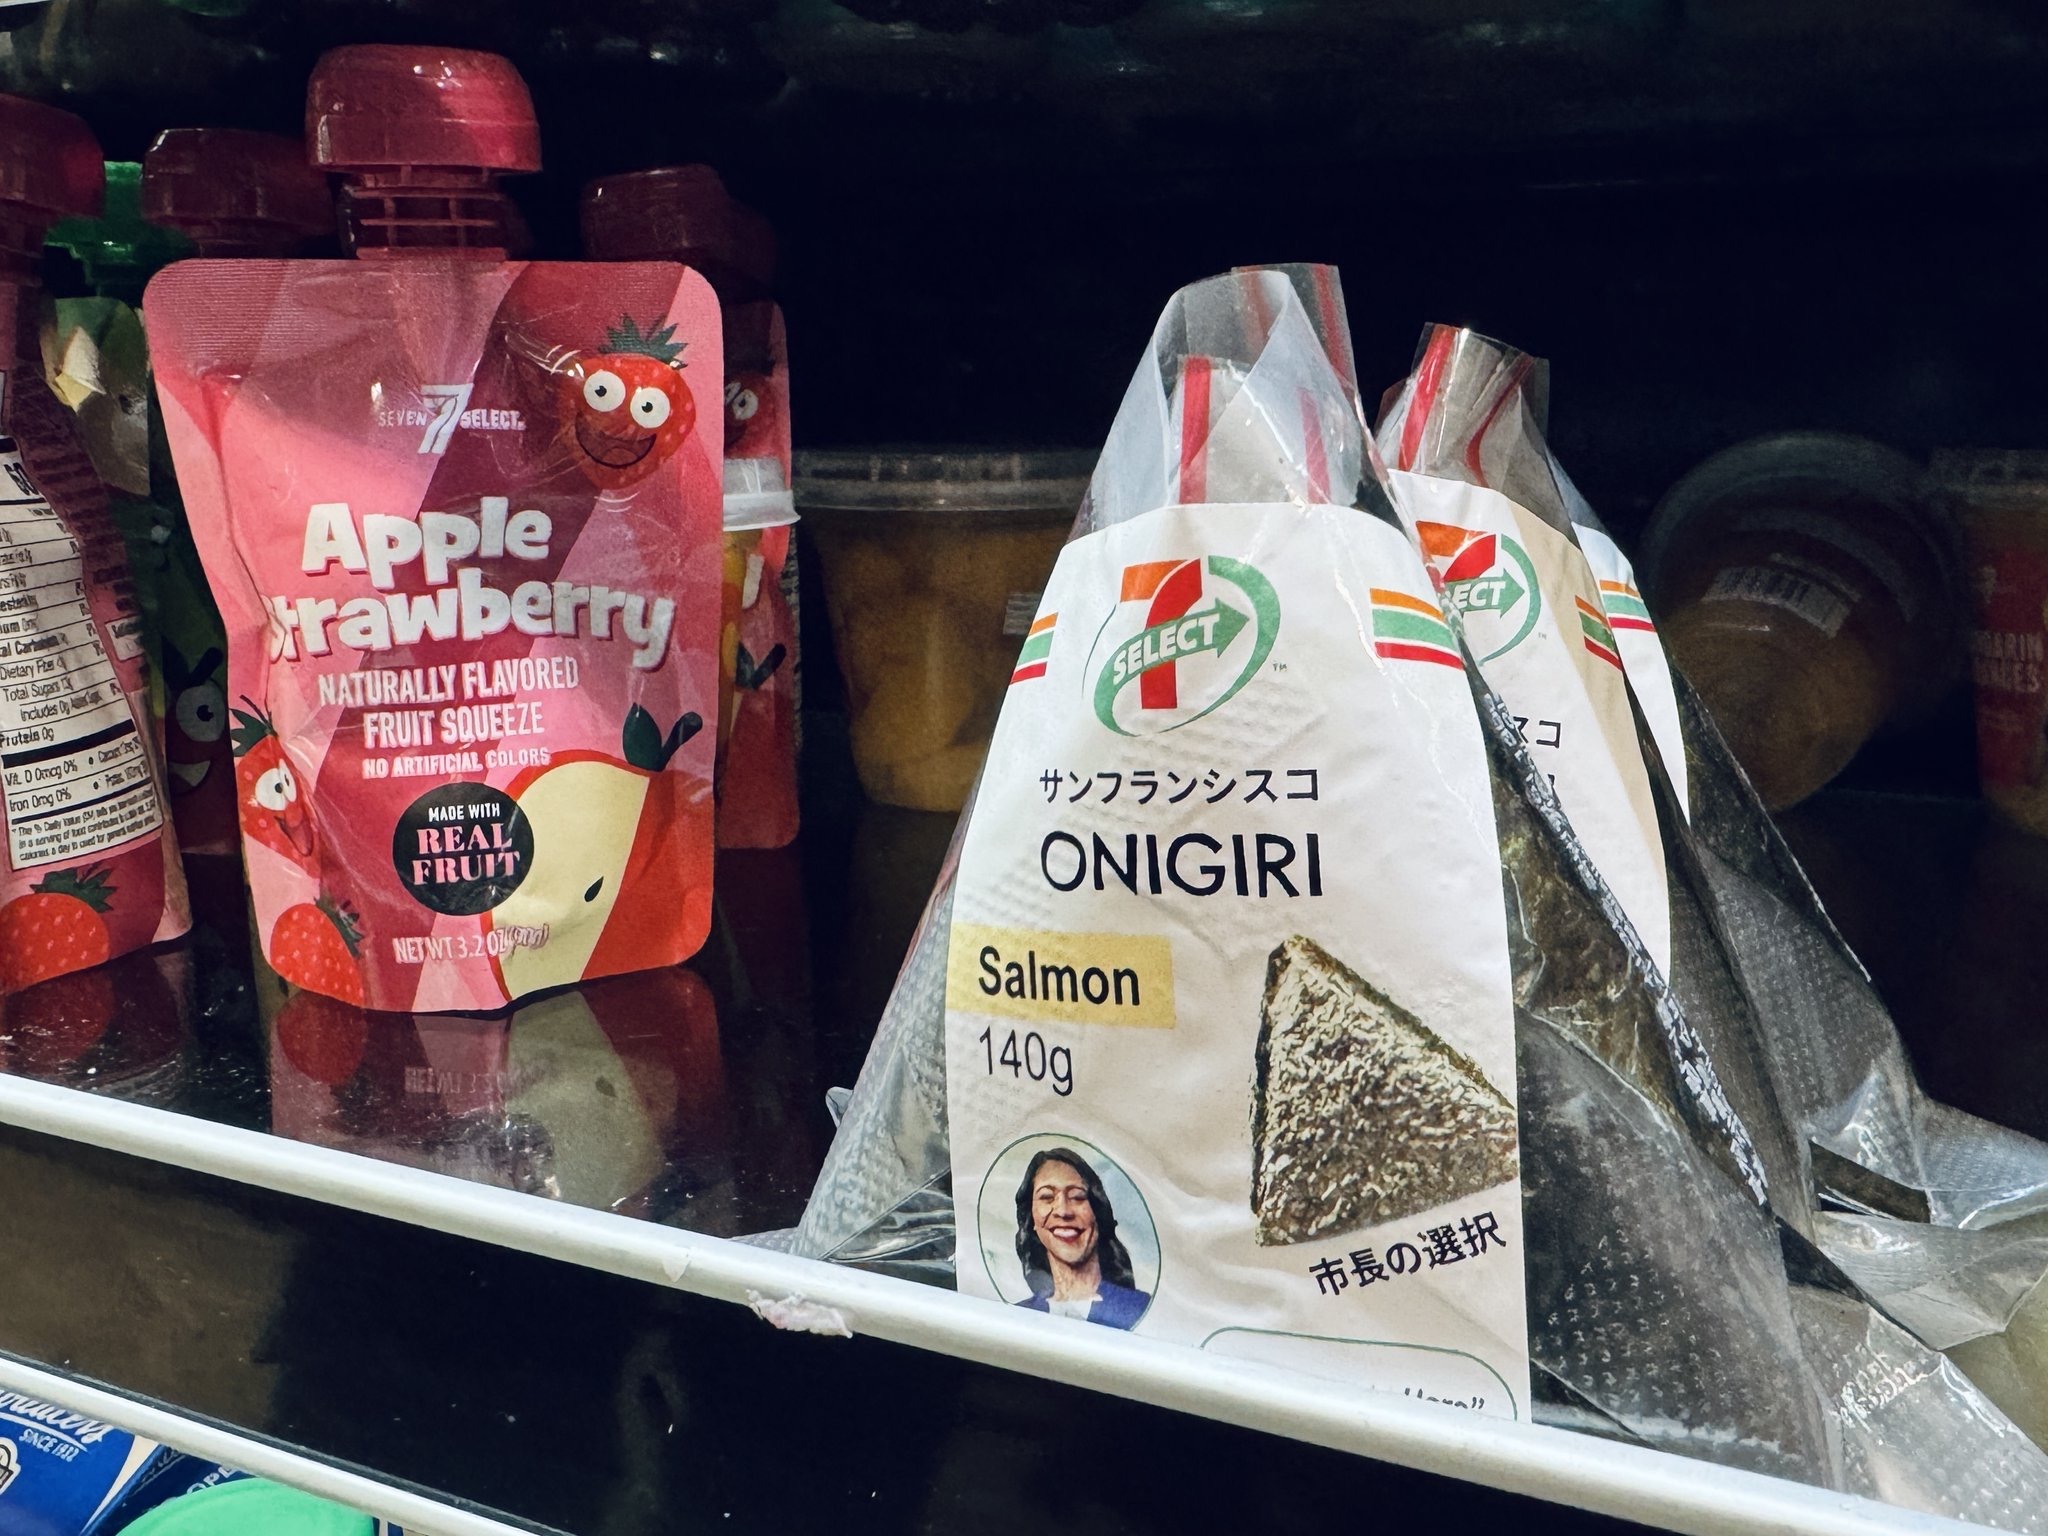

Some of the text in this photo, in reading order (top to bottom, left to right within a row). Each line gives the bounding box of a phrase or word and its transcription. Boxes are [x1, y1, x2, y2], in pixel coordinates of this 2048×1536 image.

[378, 409, 427, 428] SEVEN
[301, 496, 553, 590] Apple
[1452, 580, 1506, 610] ECT
[1111, 611, 1221, 687] SELECT
[0, 664, 34, 681] Dietary
[318, 656, 579, 708] NATURALLY FLAVORED
[3, 688, 29, 703] Total
[20, 704, 58, 722] Includes
[363, 701, 545, 749] FRUIT SQUEEZE
[362, 748, 550, 779] NO ARTIFICIAL COLORS
[1038, 768, 1320, 804] サンフランシスコ
[10, 799, 29, 813] Iron
[428, 802, 500, 822] MADE WITH
[416, 822, 513, 855] REAL
[412, 851, 521, 886] FRUIT
[1040, 830, 1323, 897] ONIGIRI
[392, 937, 424, 964] NET
[425, 937, 453, 960] WT
[458, 934, 484, 958] 3.2
[978, 945, 1141, 1007] Salmon
[978, 1025, 1074, 1096] 140g
[1309, 1210, 1508, 1297] 市長の選択
[19, 1428, 58, 1453] SINCE
